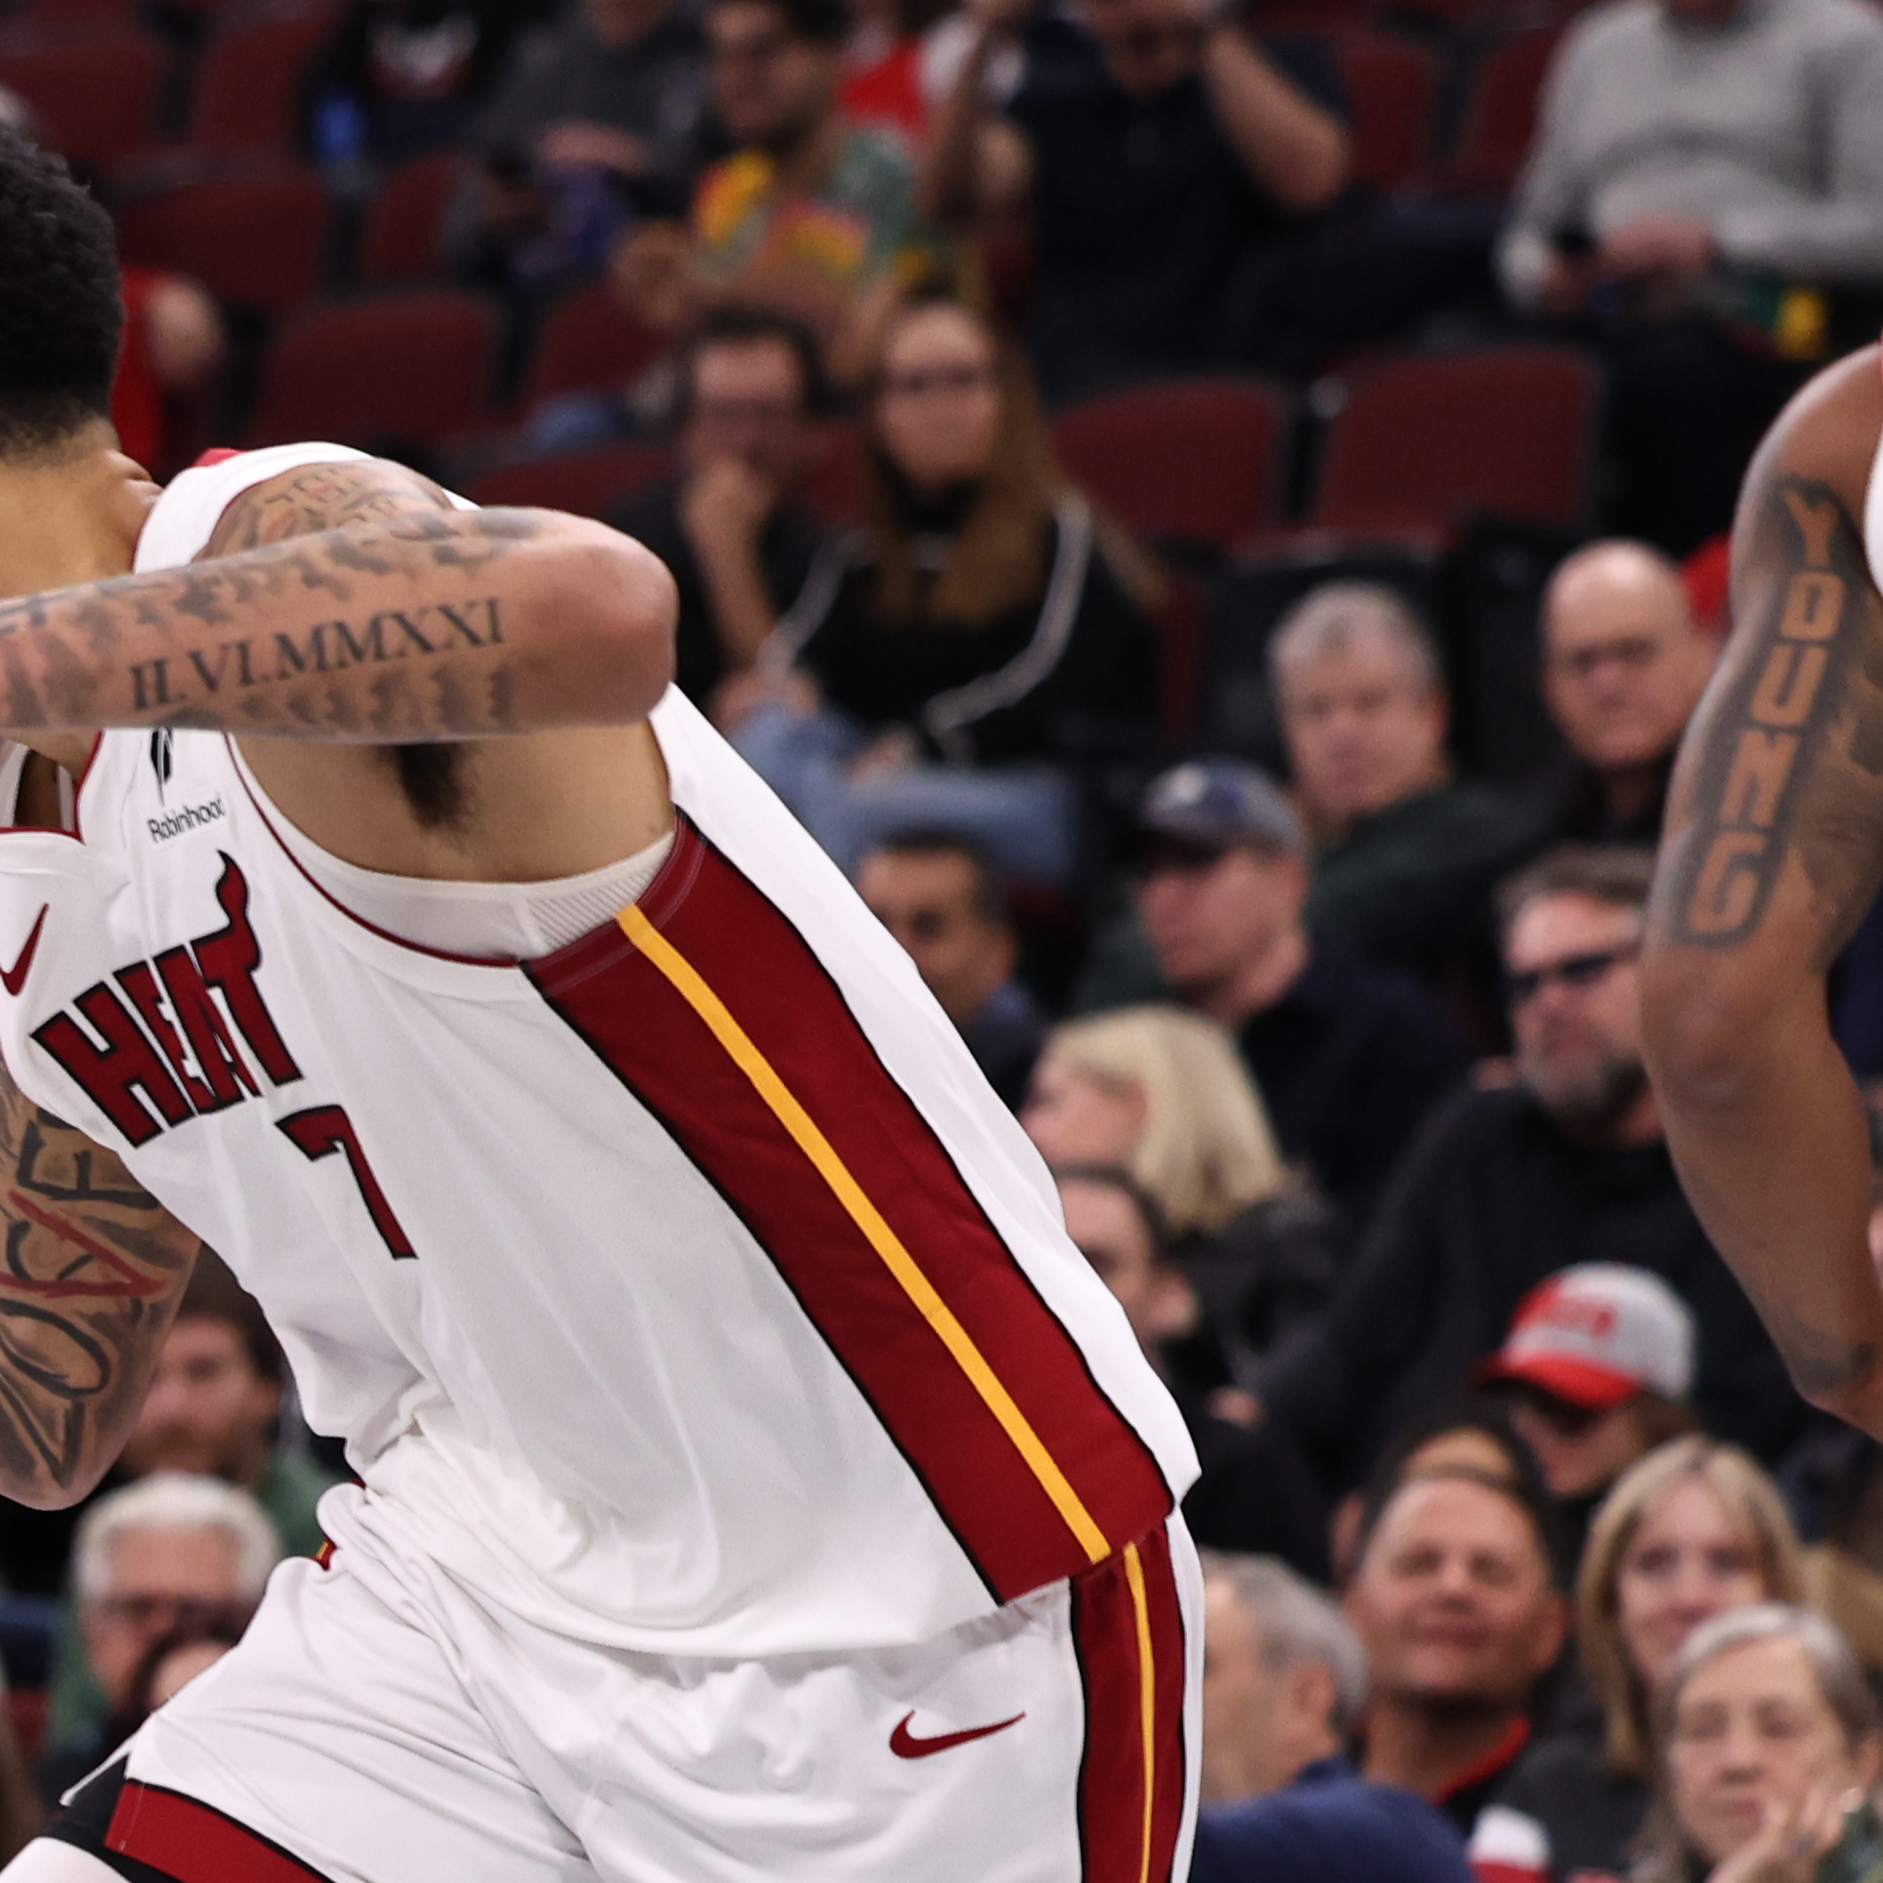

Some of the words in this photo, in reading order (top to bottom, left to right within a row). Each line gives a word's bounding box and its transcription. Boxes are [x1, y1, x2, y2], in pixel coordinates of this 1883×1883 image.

[1688, 488, 1845, 937] YOUNG
[30, 850, 304, 1148] HEAT
[274, 1105, 420, 1260] 7
